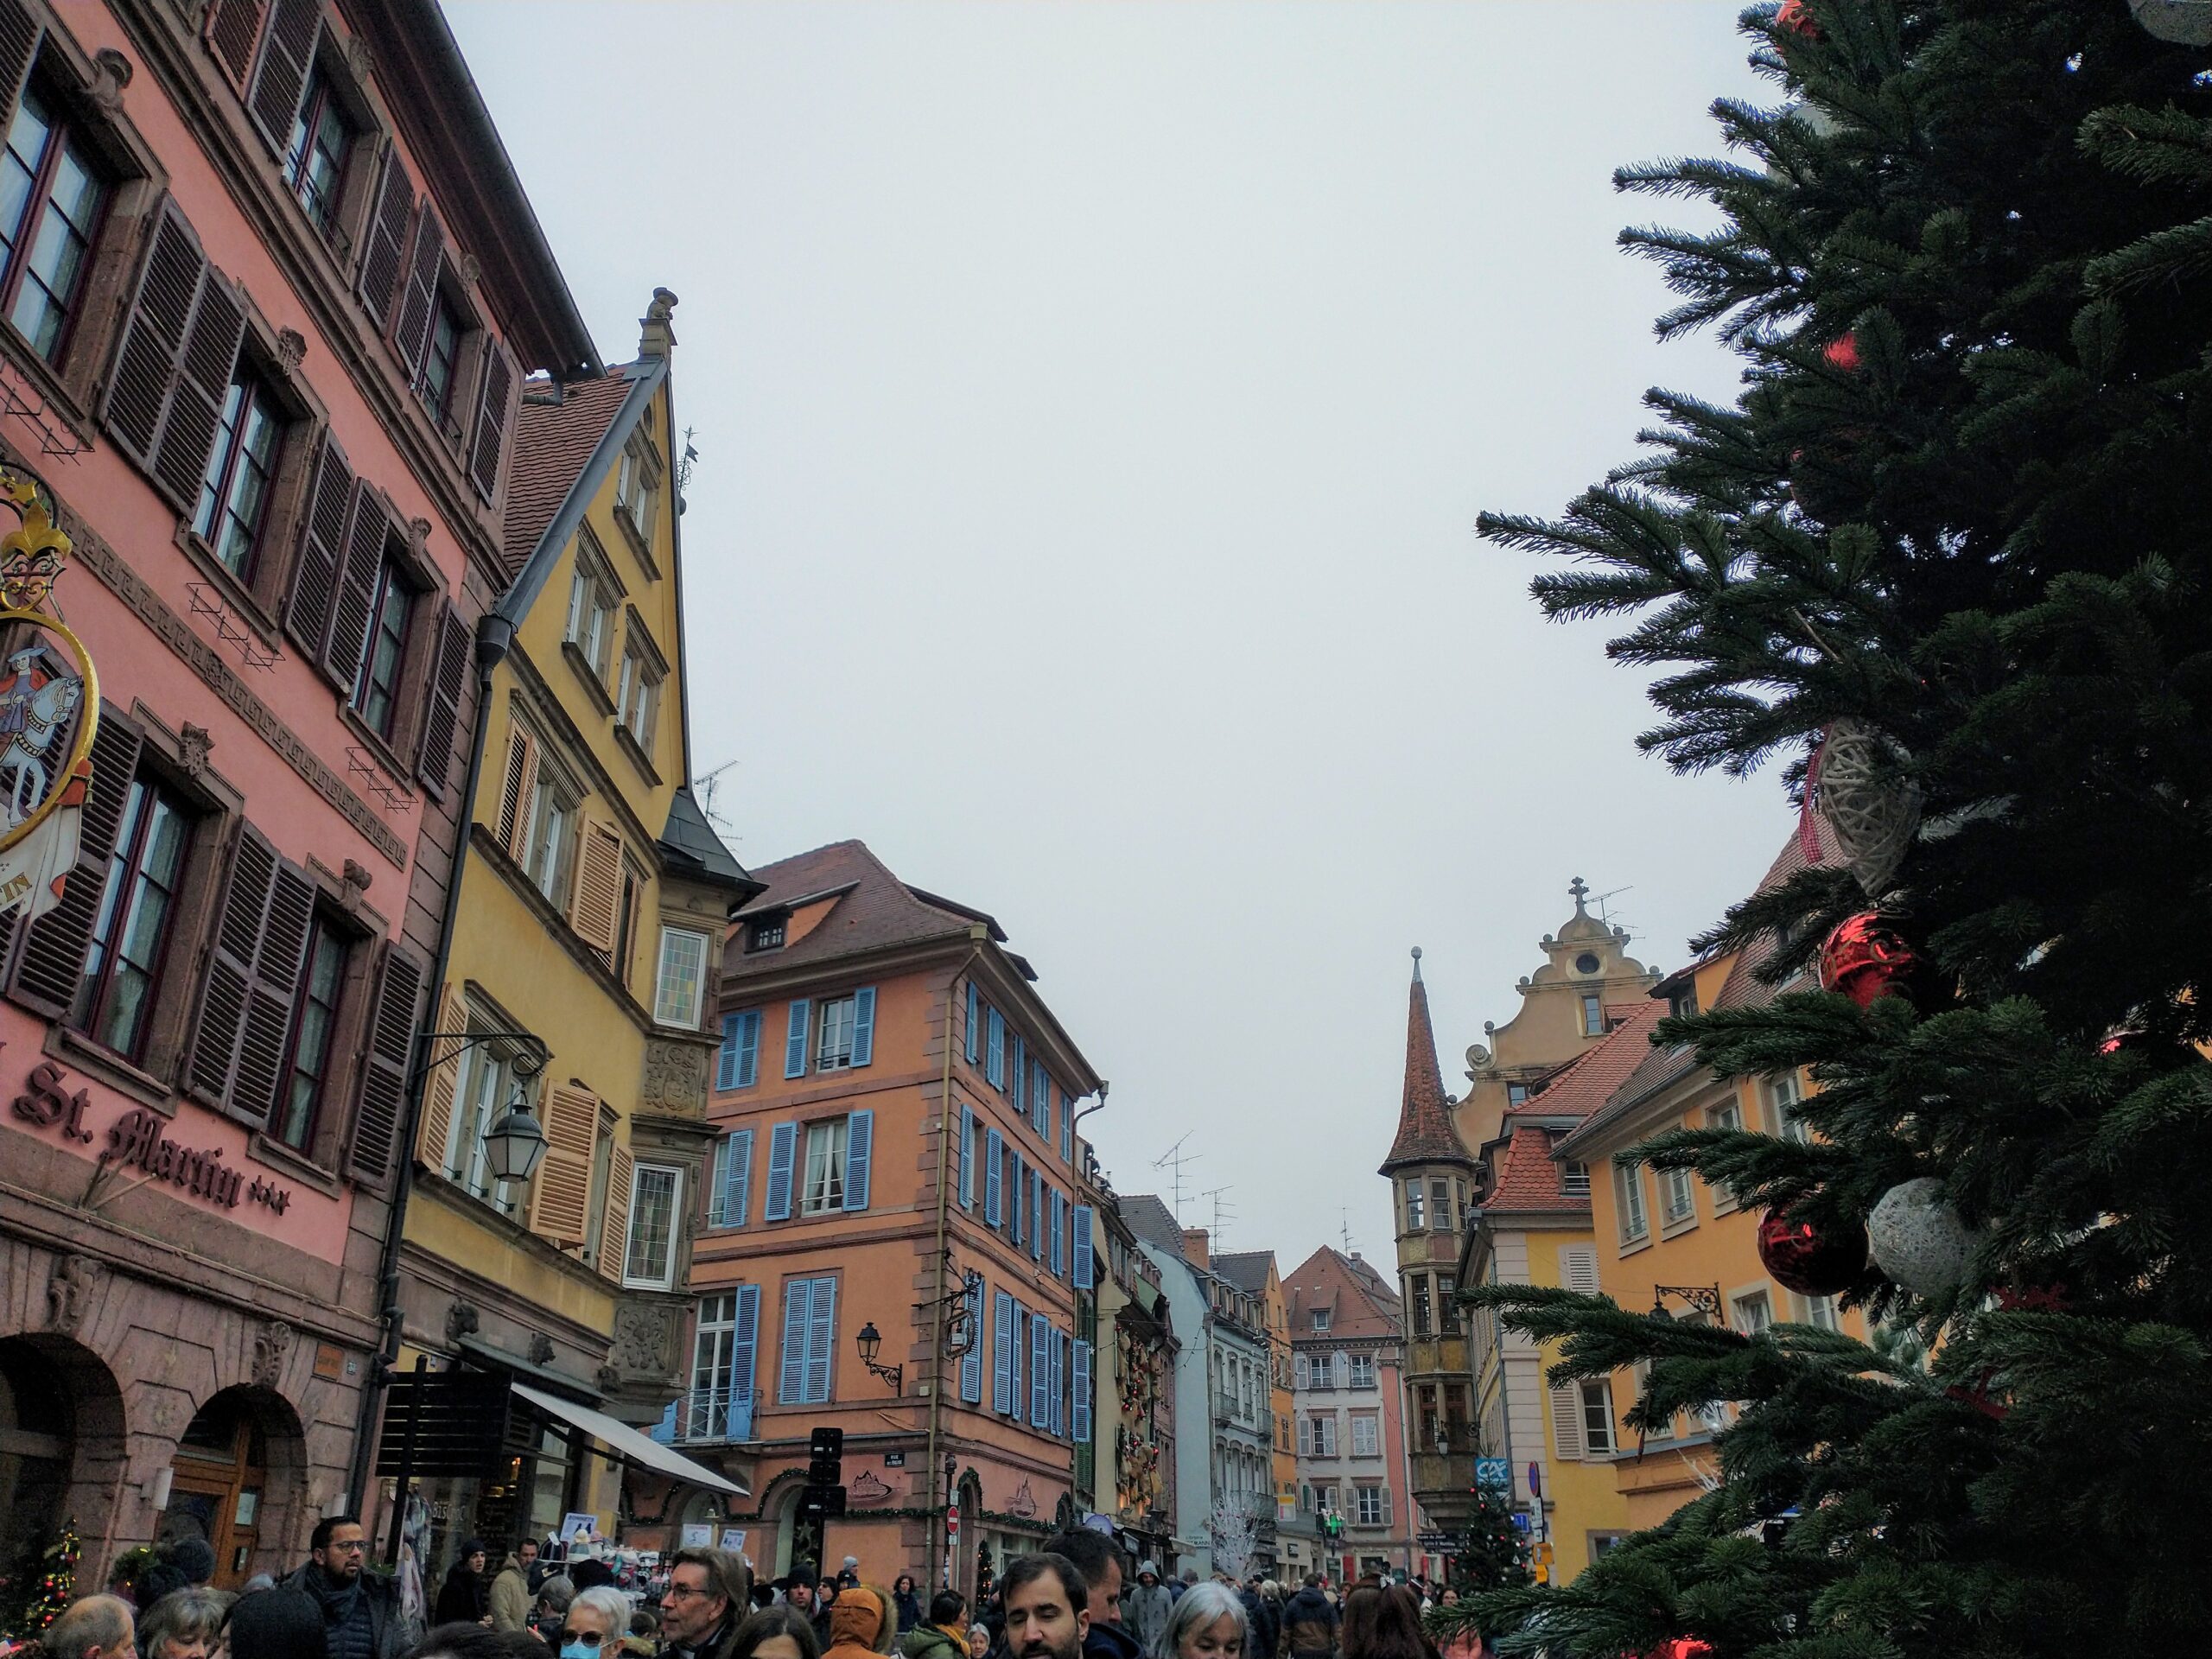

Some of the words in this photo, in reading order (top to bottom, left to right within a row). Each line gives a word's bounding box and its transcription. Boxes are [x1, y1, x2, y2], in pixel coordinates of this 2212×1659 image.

[0, 871, 32, 903] IN
[13, 1059, 93, 1144] St.
[109, 1108, 245, 1209] Martin
